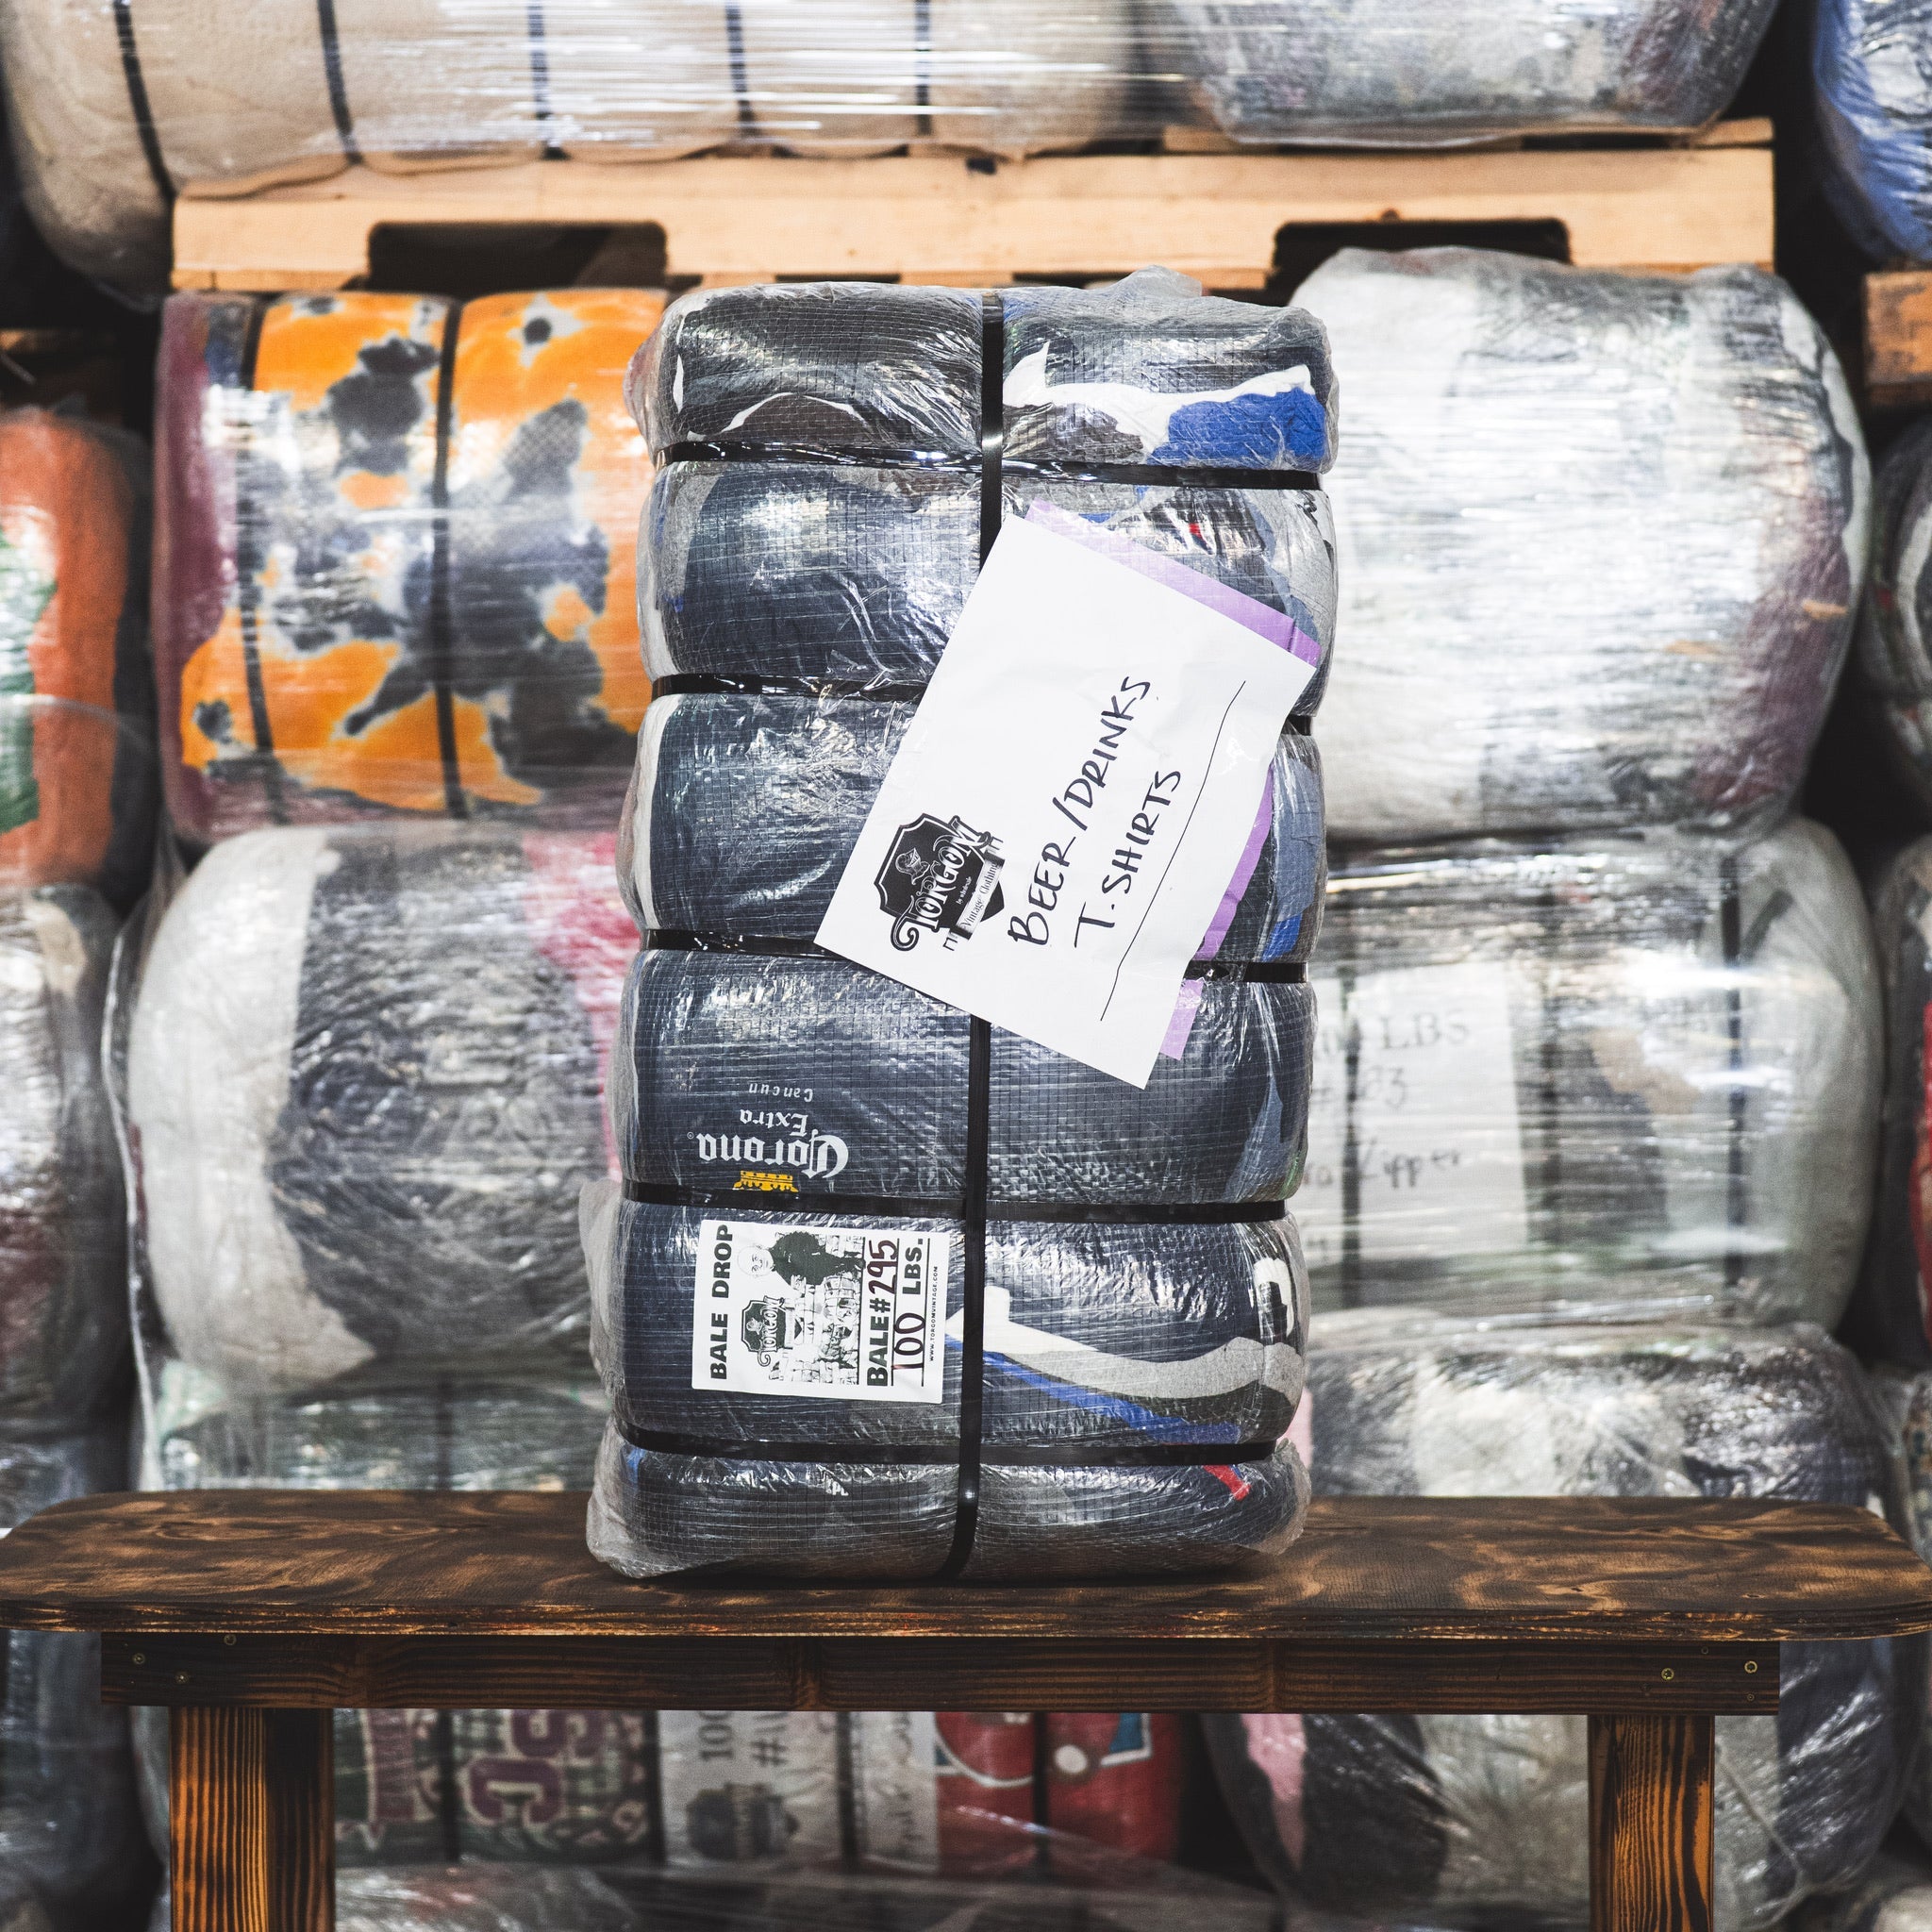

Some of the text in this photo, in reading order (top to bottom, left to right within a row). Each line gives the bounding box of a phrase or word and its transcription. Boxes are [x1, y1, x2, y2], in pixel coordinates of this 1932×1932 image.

[891, 815, 991, 952] TORGOM
[960, 898, 983, 927] Vintage
[740, 1108, 808, 1137] Extra
[748, 1083, 813, 1103] Cancun
[695, 1129, 849, 1178] Corona
[709, 1224, 734, 1380] BALE DROP
[757, 1294, 787, 1367] TORGOM
[891, 1238, 926, 1371] 100 LBS.
